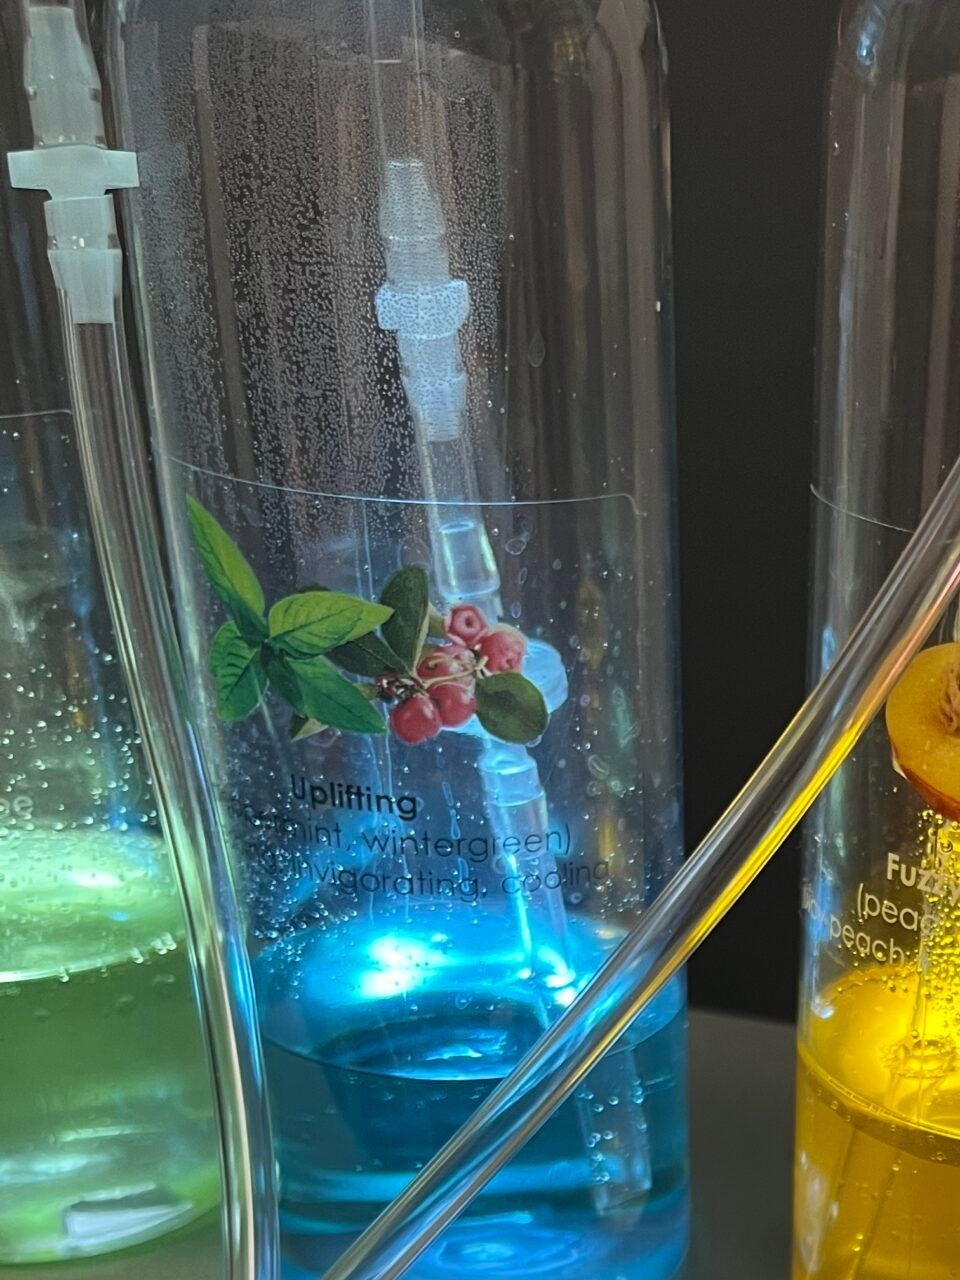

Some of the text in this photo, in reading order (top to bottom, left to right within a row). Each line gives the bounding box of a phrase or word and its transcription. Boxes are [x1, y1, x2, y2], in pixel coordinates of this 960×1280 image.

[290, 774, 418, 821] Uplifting
[362, 823, 571, 864] wintergreen)
[829, 914, 905, 967] peach
